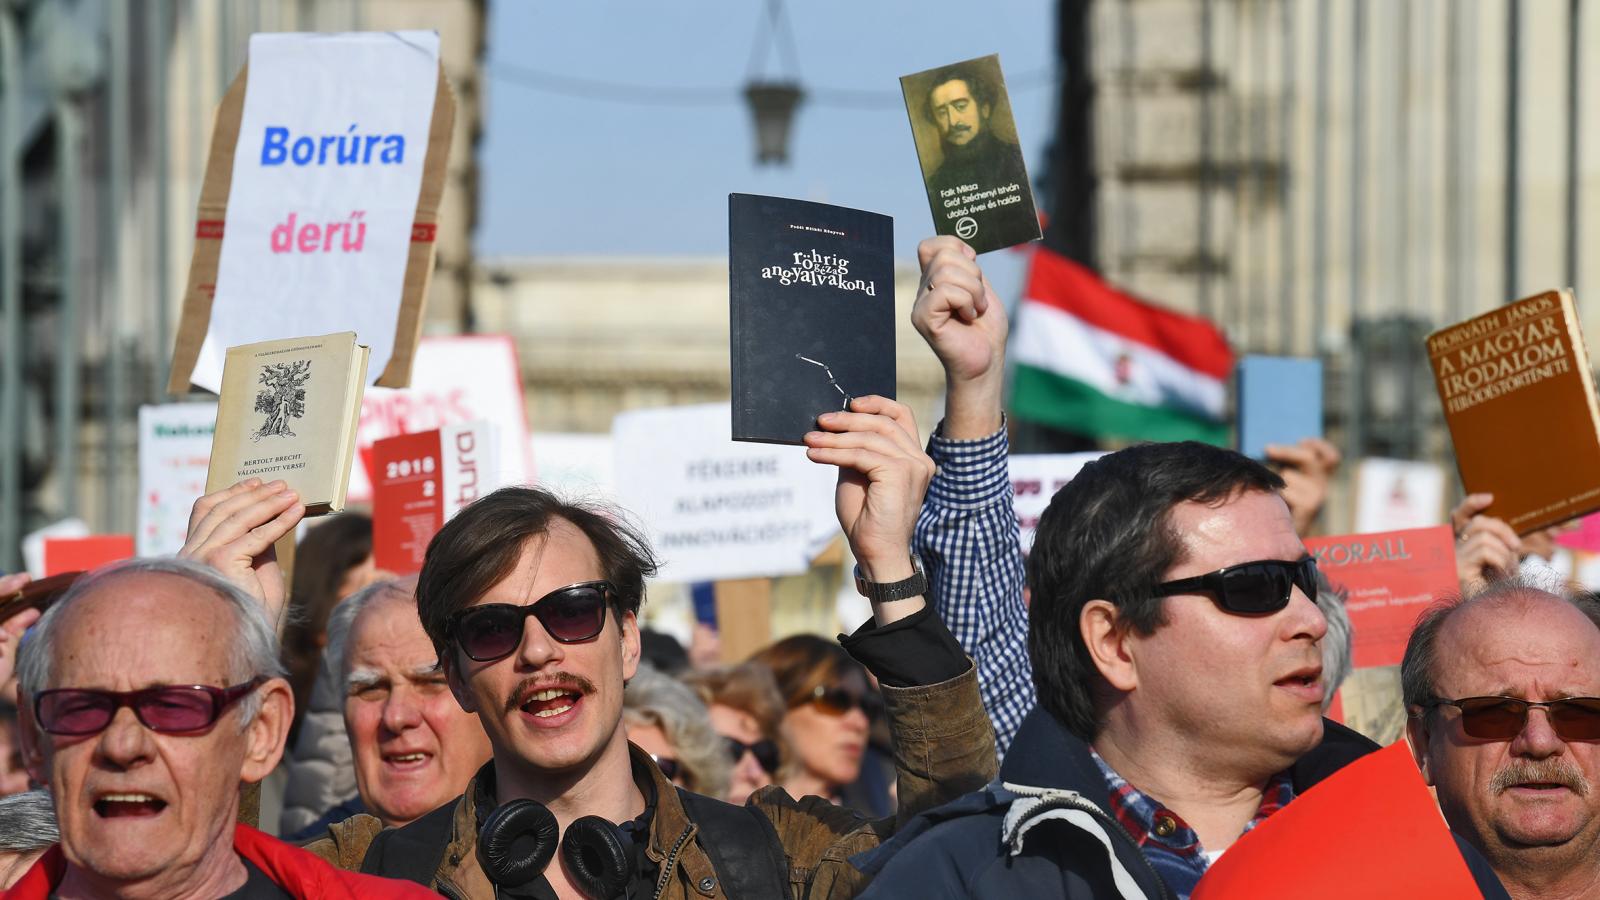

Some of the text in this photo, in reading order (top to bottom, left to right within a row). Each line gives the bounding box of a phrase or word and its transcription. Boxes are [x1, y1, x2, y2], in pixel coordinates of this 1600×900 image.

[260, 124, 405, 167] Borúra
[940, 183, 979, 198] Falk Miksa
[944, 182, 1020, 208] Gróf Széchenyi István
[947, 194, 1021, 219] utolsó évei és halála
[270, 210, 366, 254] derű
[793, 248, 849, 275] röhrig
[814, 263, 838, 275] géza
[761, 265, 876, 296] angyalvakond
[1430, 296, 1554, 353] HORVÁTH JÁNOS
[1440, 316, 1560, 377] A MAGYAR
[1443, 337, 1566, 398] IRODALOM
[237, 461, 306, 476] VÁLOGATOTT VERSEI
[244, 453, 302, 466] BERTOLT BRECHT
[386, 456, 435, 479] 2018
[422, 480, 435, 497] 2
[674, 488, 796, 515] ALAPOZOTT
[1313, 538, 1411, 567] KORALL
